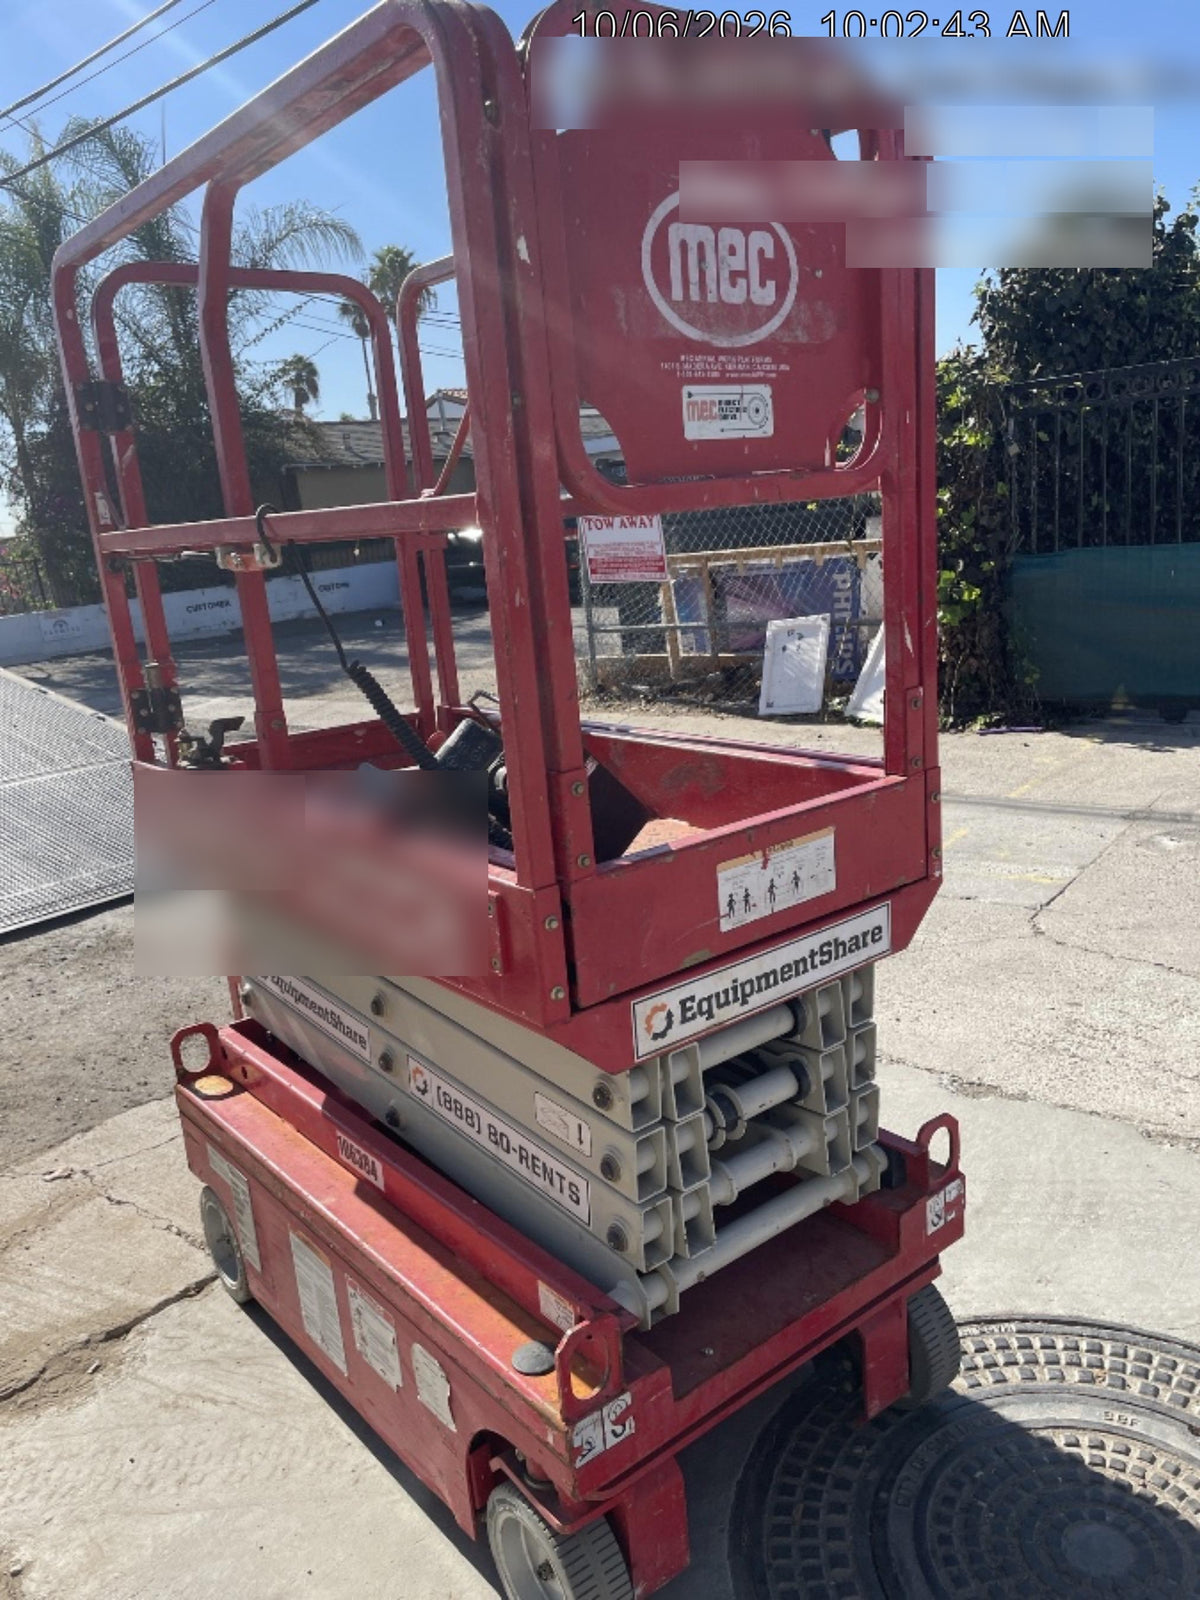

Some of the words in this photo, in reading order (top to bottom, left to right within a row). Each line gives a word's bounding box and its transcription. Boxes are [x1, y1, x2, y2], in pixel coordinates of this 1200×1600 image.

[584, 517, 614, 531] TOW
[619, 515, 655, 529] AWAY
[185, 600, 232, 613] CUSTOMER
[679, 924, 883, 1022] EquipmentShare
[261, 976, 368, 1050] quipmentShare
[436, 1086, 481, 1135] (888)
[487, 1123, 581, 1206] 80-RENTS
